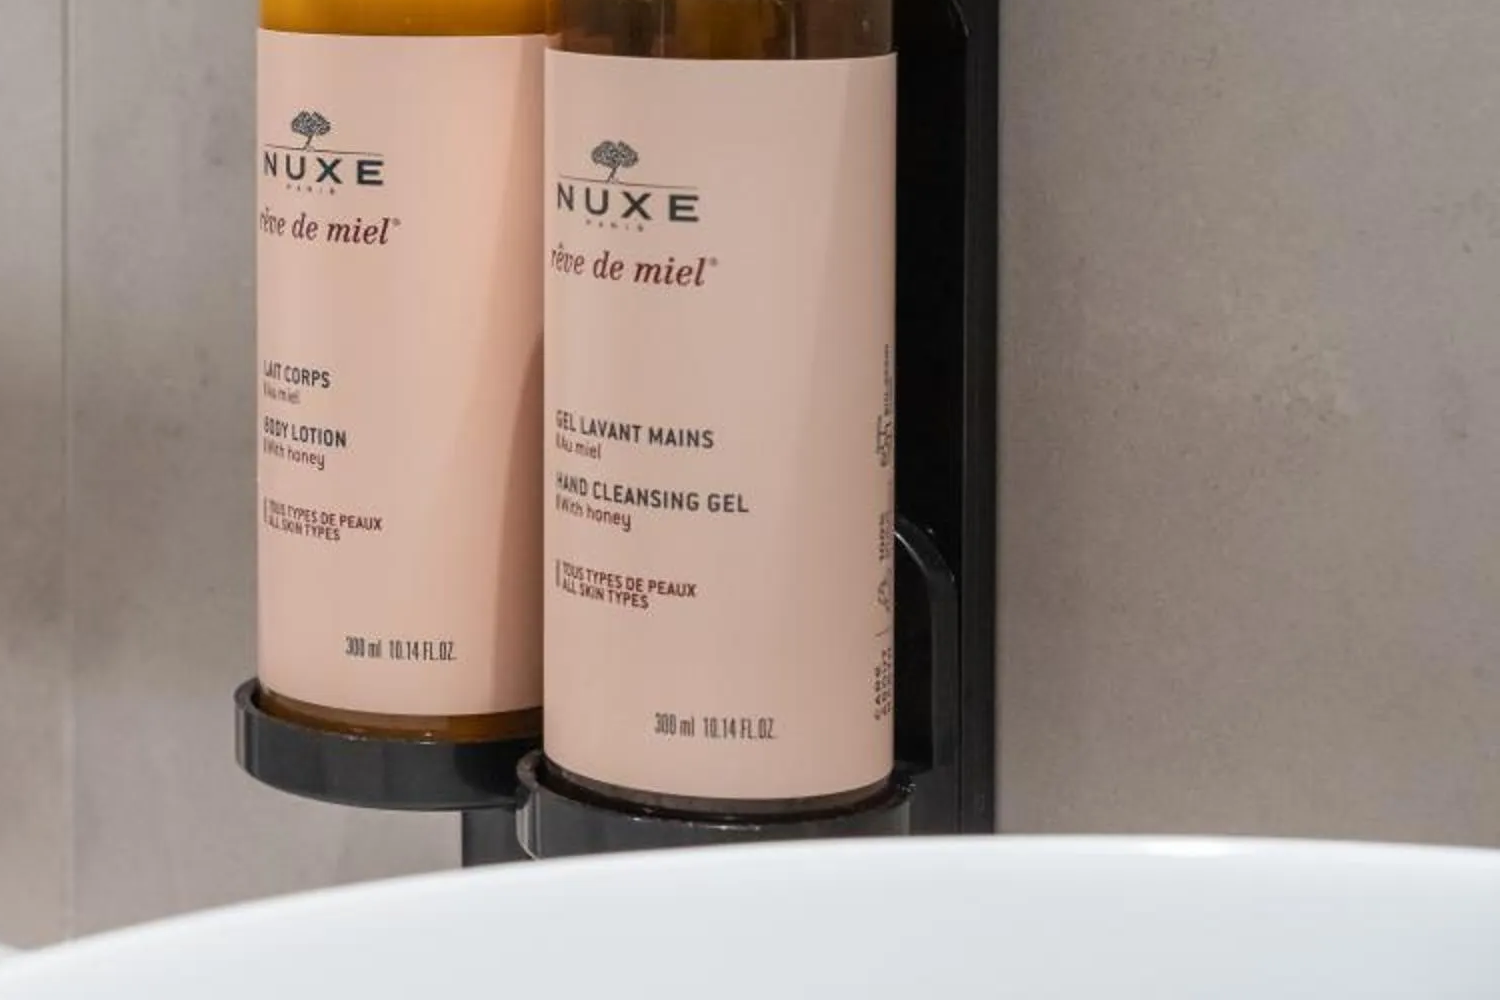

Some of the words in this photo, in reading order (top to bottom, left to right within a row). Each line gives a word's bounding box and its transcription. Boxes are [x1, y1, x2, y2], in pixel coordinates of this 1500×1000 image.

[263, 151, 385, 186] NUXE
[557, 181, 700, 223] NUXE
[291, 211, 319, 241] de
[551, 241, 585, 276] rêve
[593, 250, 625, 282] de
[284, 364, 332, 389] CORPS
[291, 422, 347, 449] LOTION
[556, 409, 577, 432] GEL
[580, 415, 642, 444] LAVANT
[648, 426, 715, 450] MAINS
[287, 444, 325, 471] honey
[593, 480, 700, 513] CLEANSING
[707, 493, 750, 514] GEL
[304, 522, 340, 541] TYPES
[320, 511, 337, 527] DE
[339, 514, 383, 531] PEAUX
[586, 502, 631, 533] honey
[586, 568, 623, 589] TYPES
[625, 576, 645, 593] DE
[647, 579, 697, 598] PEAUX
[607, 588, 649, 610] TYPES
[345, 636, 365, 658] 300
[654, 712, 677, 736] 300
[680, 716, 695, 737] ml
